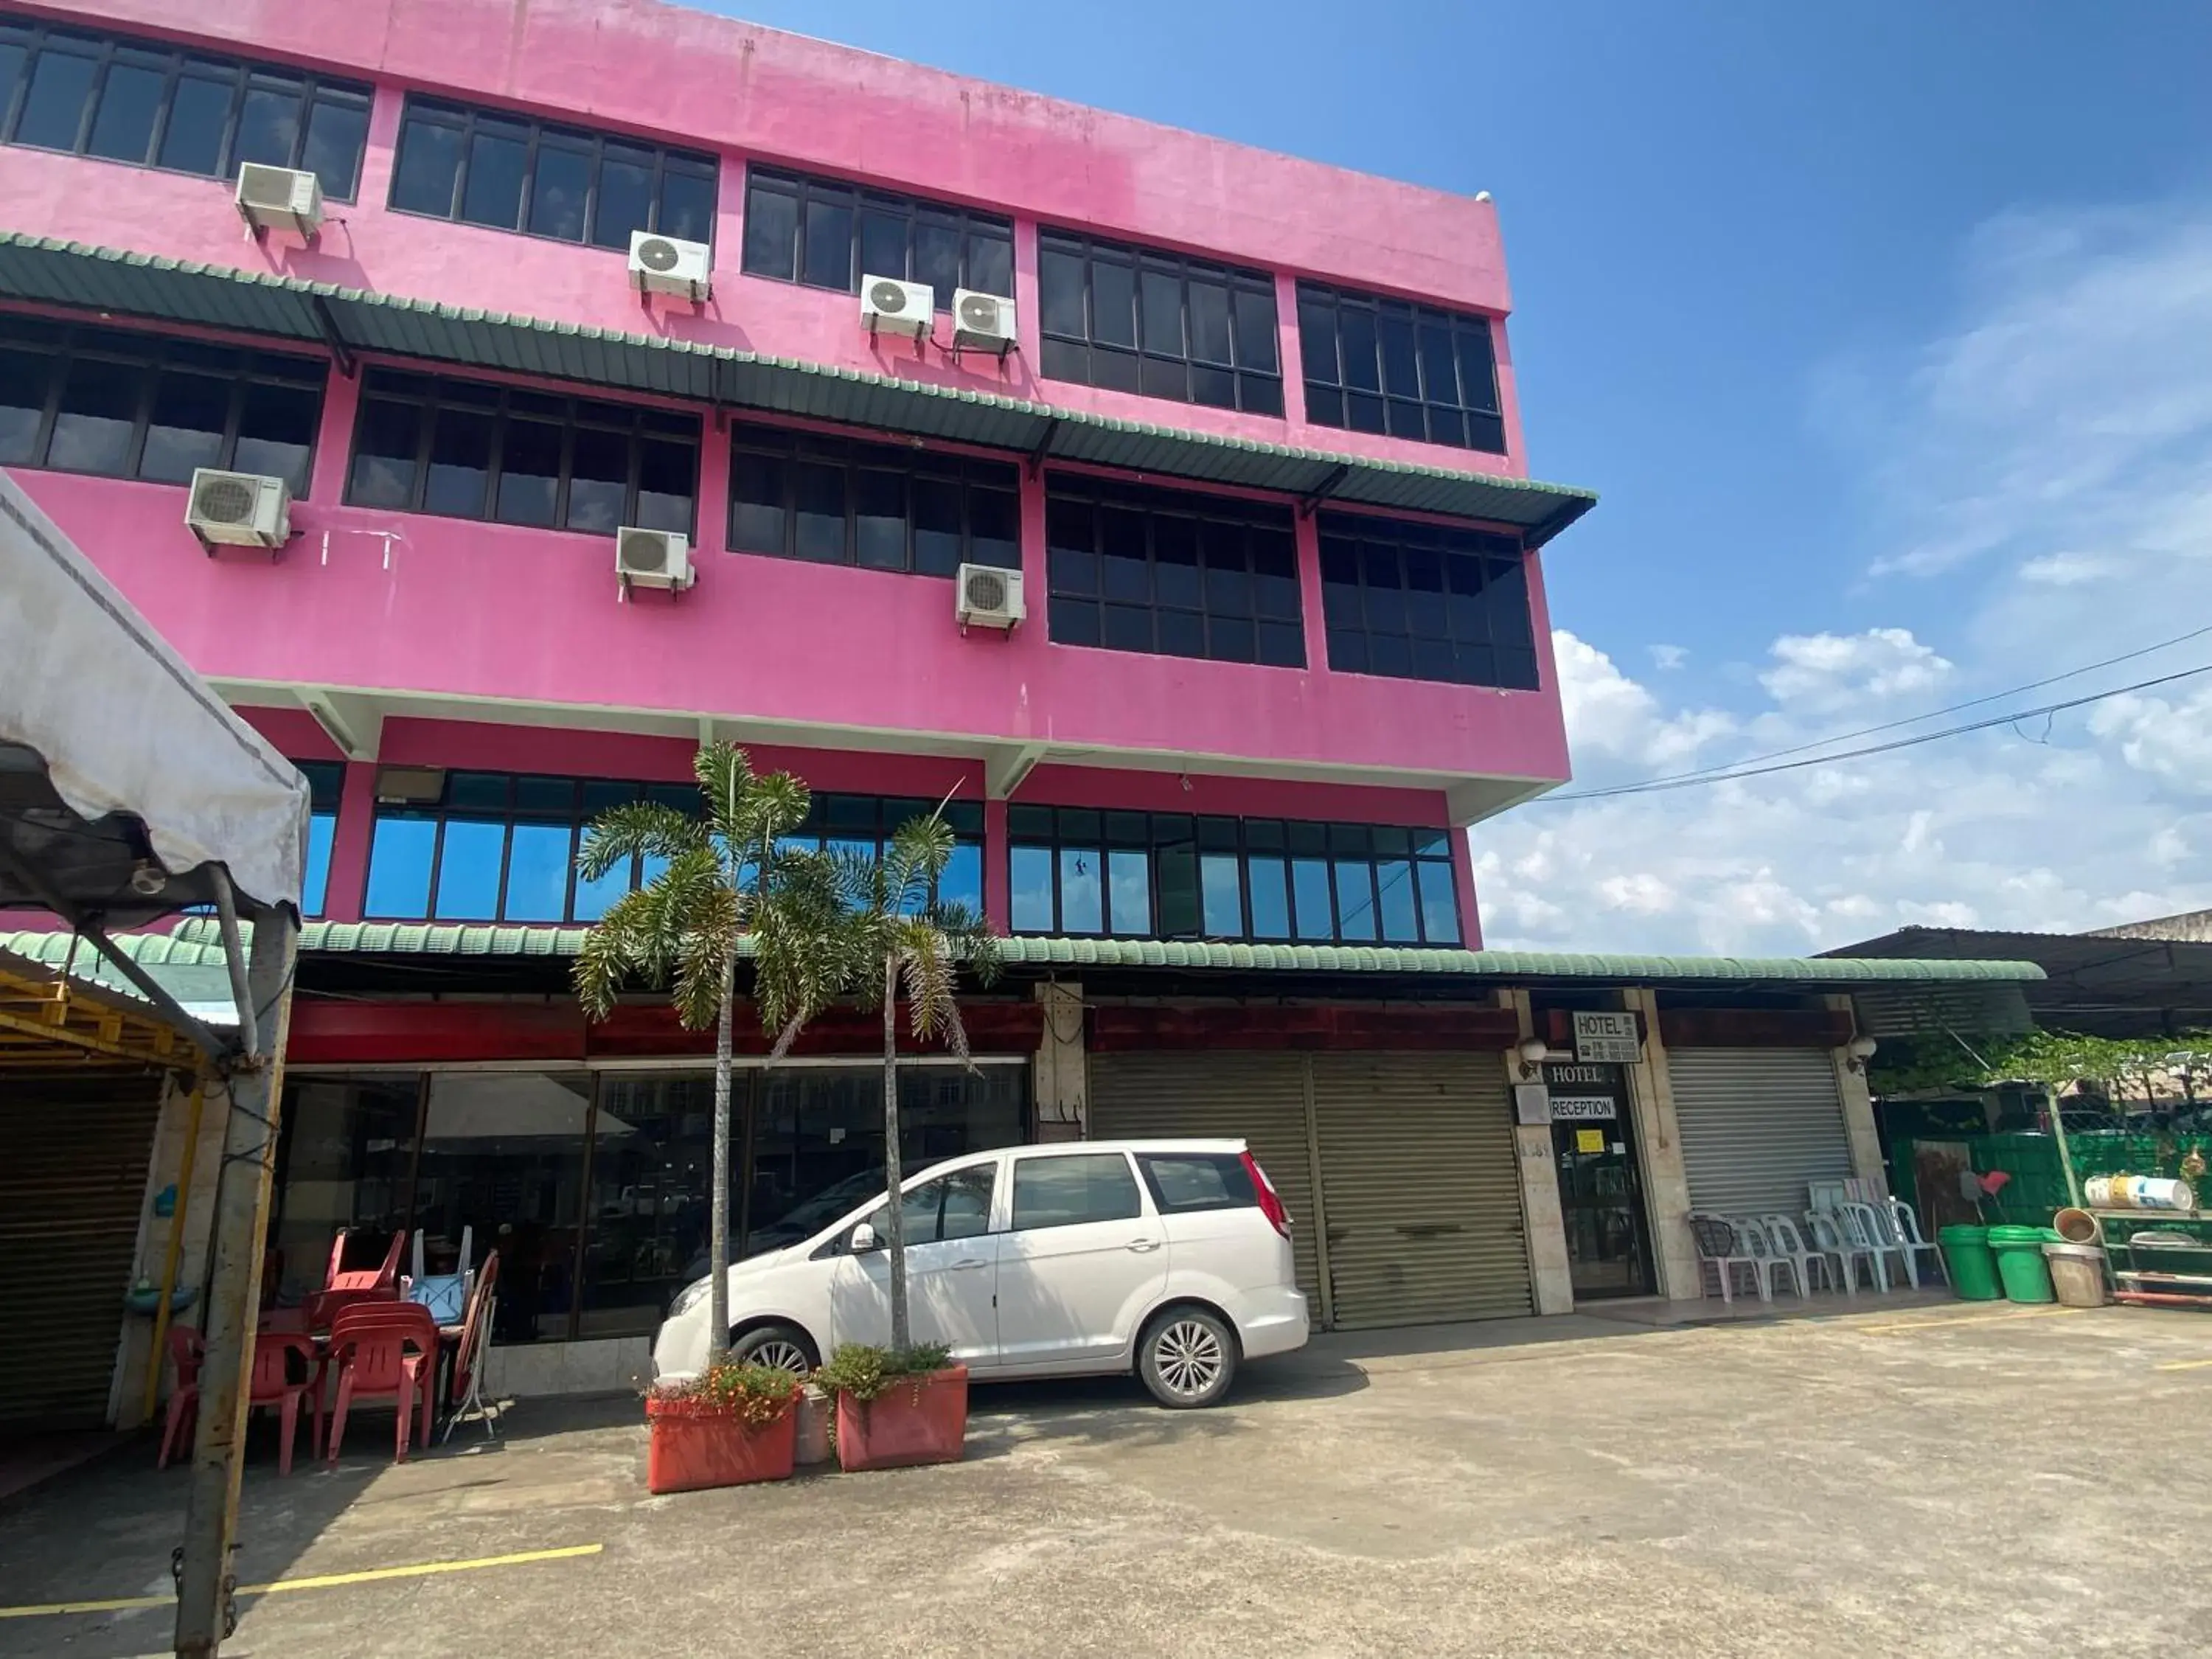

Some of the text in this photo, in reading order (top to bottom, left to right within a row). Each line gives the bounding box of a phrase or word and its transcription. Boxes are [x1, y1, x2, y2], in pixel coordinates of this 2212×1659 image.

[1579, 1015, 1621, 1034] HOTEL
[1552, 1066, 1601, 1082] HOTEL
[1552, 1101, 1611, 1115] RECEPTION
